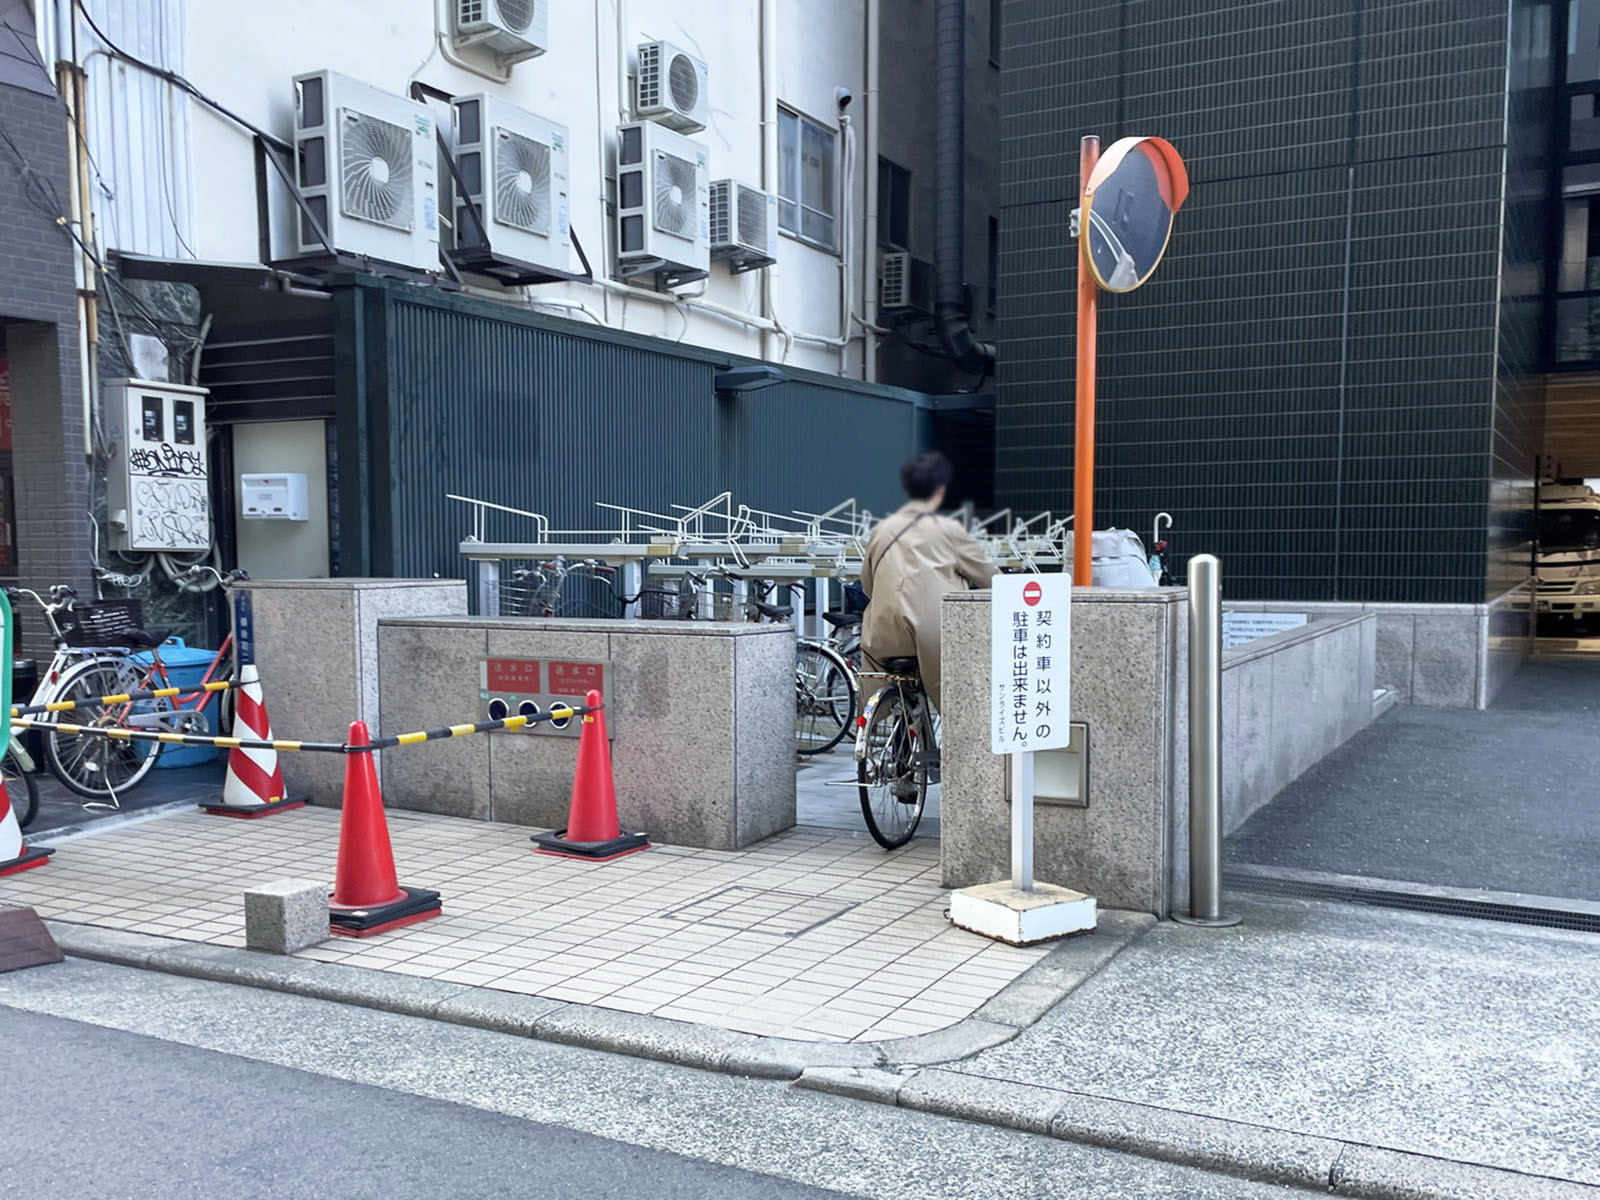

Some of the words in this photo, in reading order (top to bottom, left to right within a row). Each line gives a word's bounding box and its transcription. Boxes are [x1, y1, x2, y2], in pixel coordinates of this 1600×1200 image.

[1012, 611, 1029, 748] 駐車は出来ません。
[1036, 610, 1052, 739] 契約車以外の
